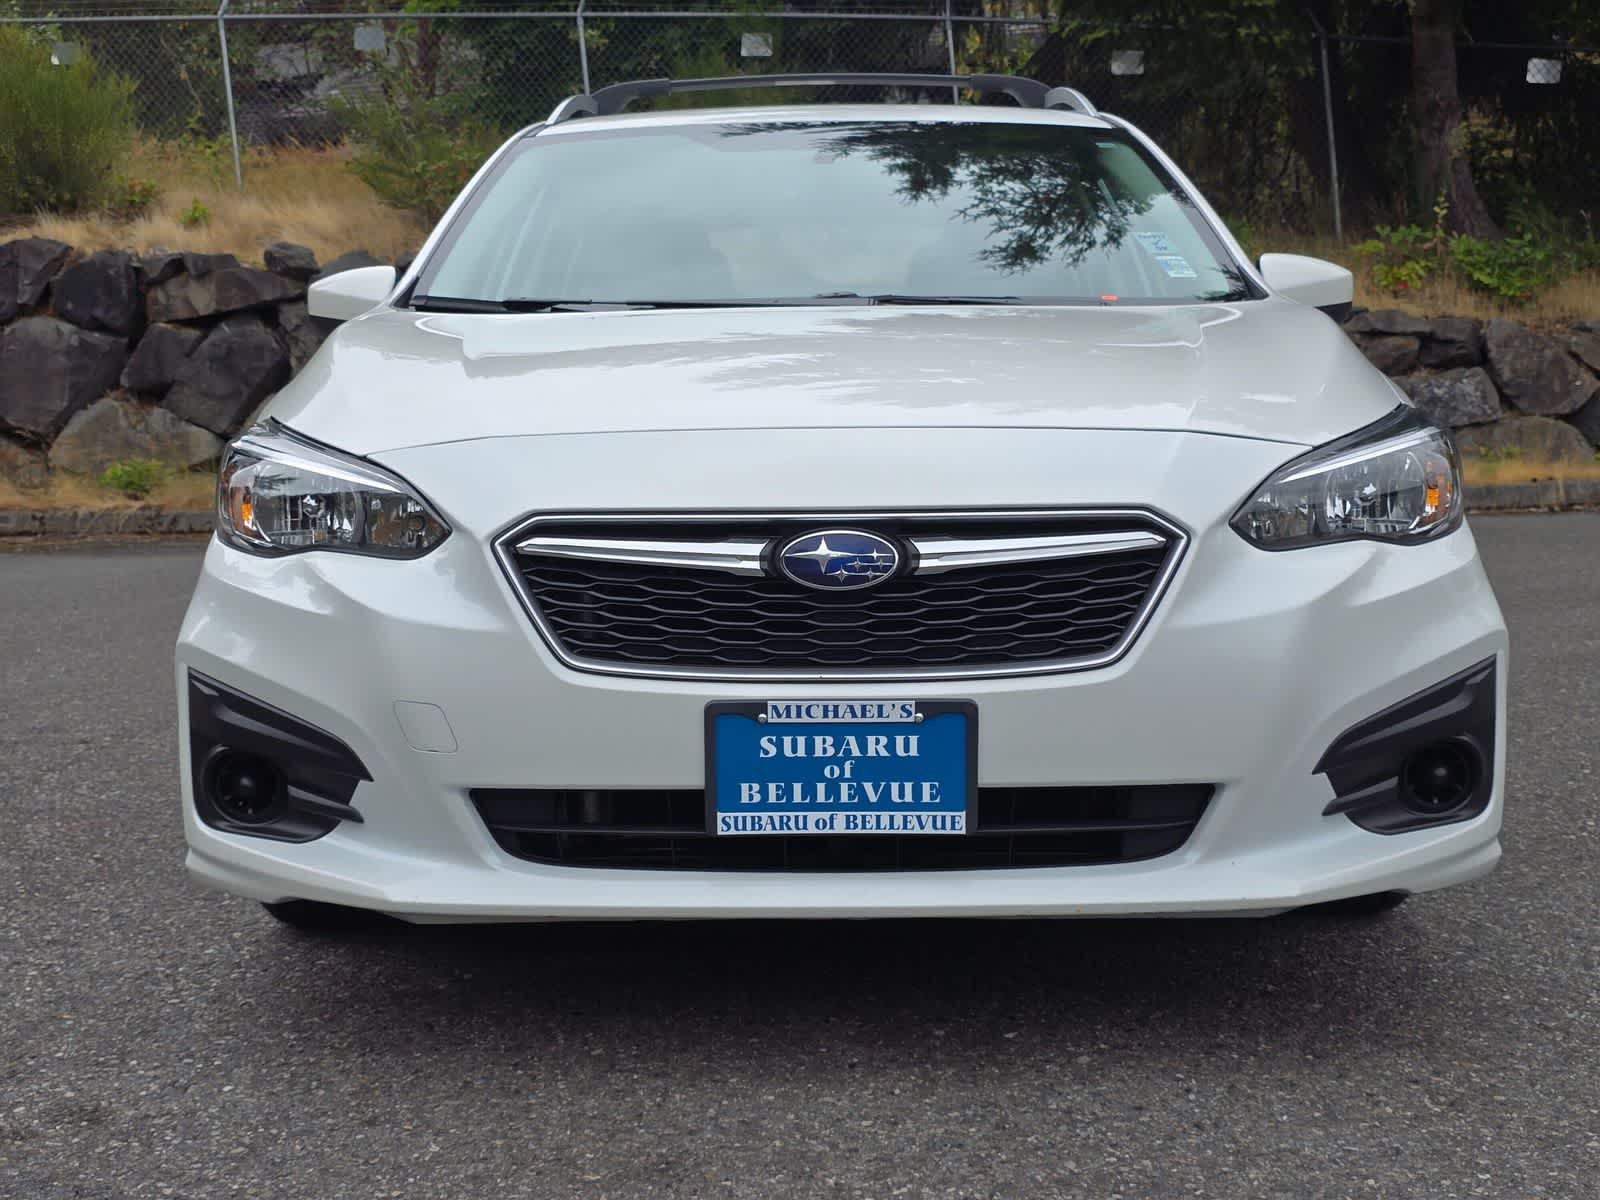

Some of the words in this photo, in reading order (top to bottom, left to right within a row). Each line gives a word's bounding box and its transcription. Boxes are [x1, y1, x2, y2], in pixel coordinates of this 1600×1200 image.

[770, 703, 913, 720] MICHAEL'S
[759, 735, 920, 758] SUBARU
[823, 760, 855, 779] of
[739, 782, 942, 804] BELLEVUE
[720, 815, 809, 832] SUBARU
[814, 813, 838, 831] of
[844, 814, 964, 831] BELLEVUE
